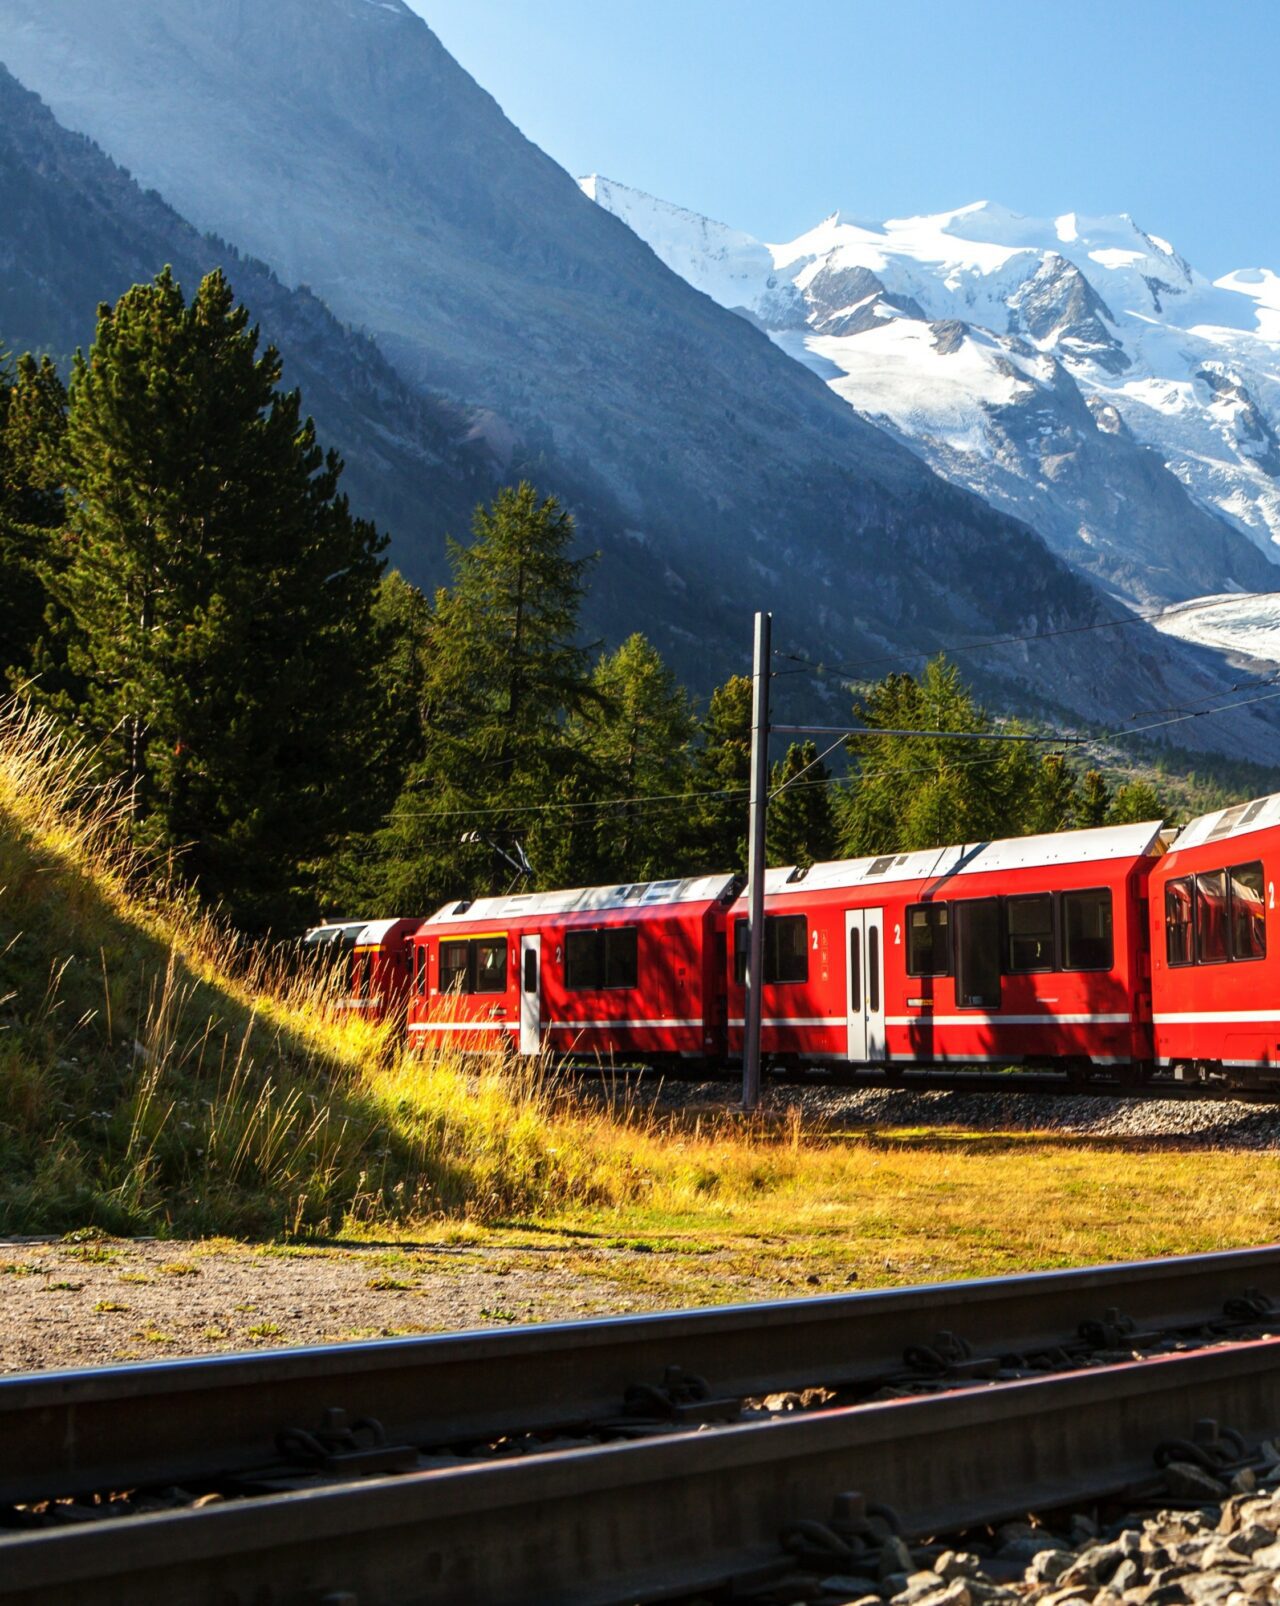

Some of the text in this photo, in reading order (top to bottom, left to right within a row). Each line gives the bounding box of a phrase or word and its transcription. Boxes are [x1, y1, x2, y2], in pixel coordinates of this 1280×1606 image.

[1268, 881, 1275, 910] 2
[812, 930, 818, 950] 2
[894, 924, 901, 945] 2
[556, 946, 561, 963] 2
